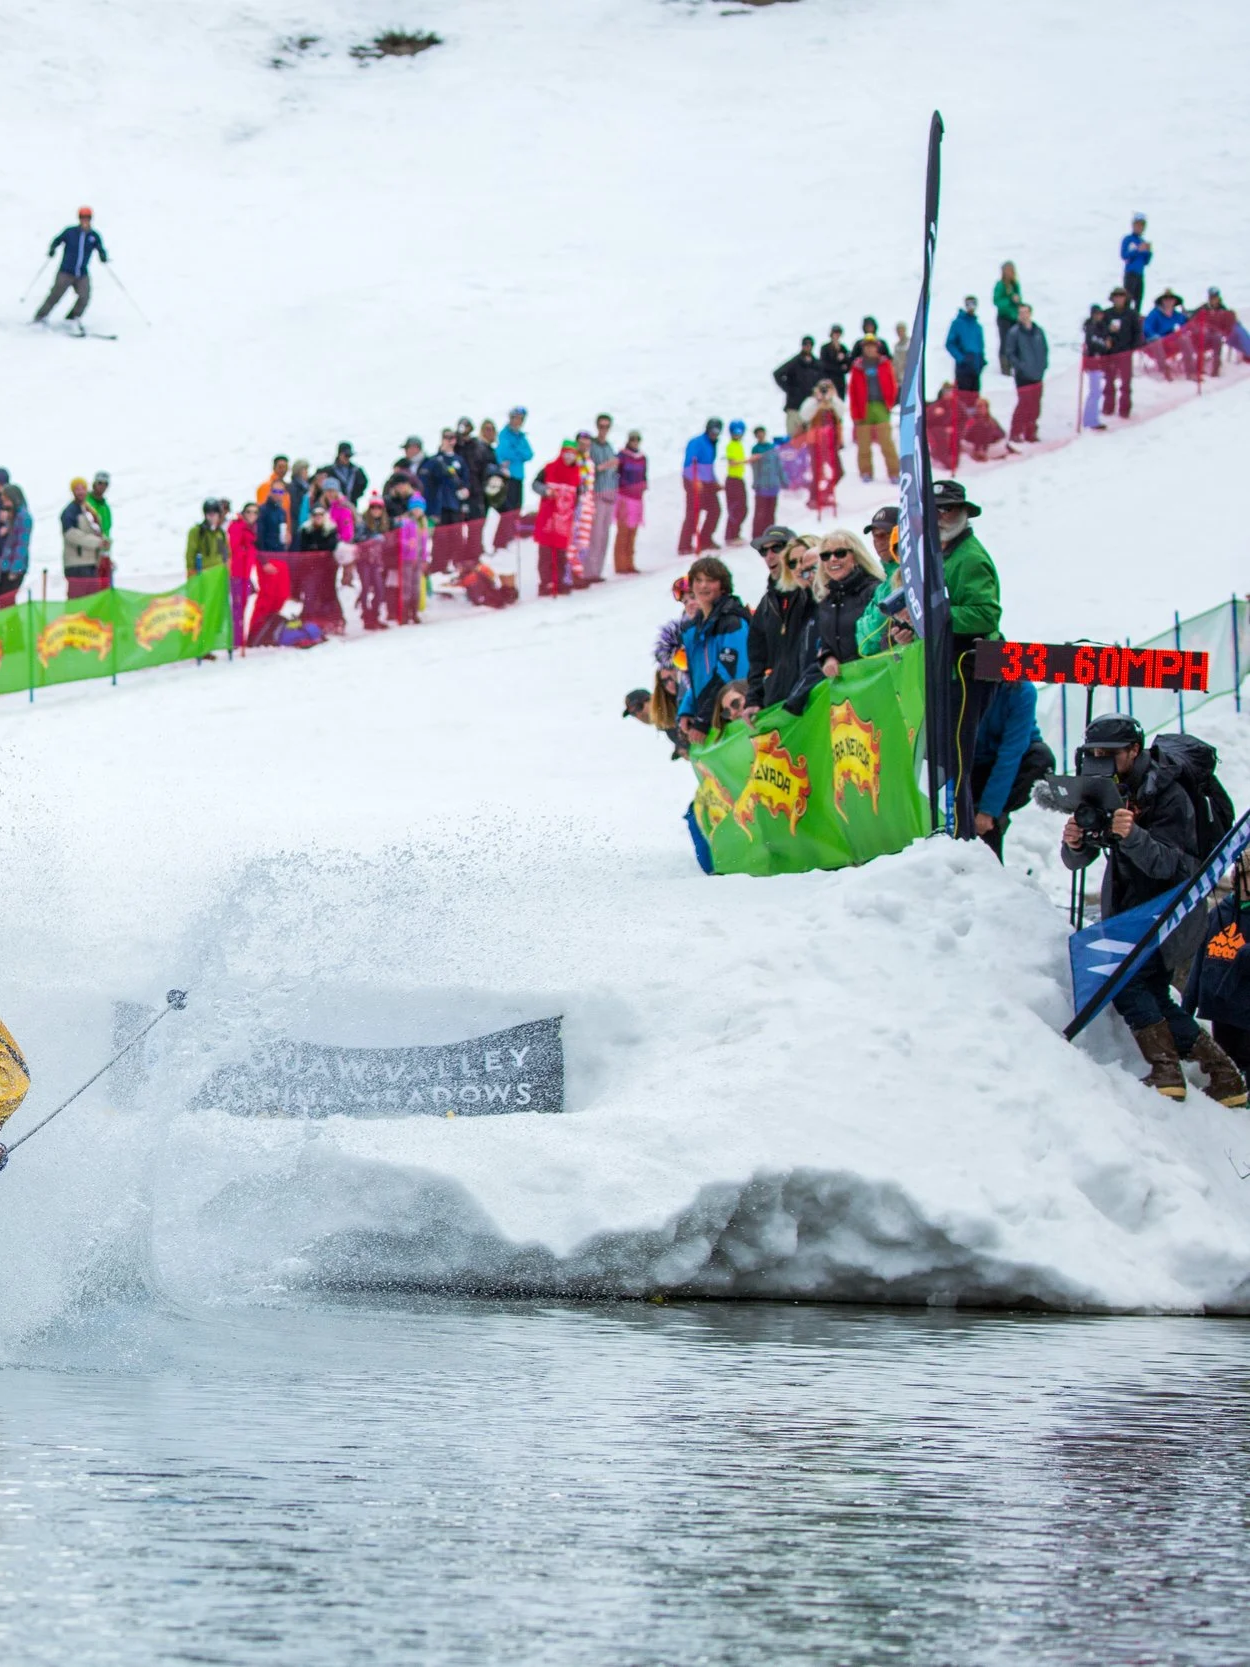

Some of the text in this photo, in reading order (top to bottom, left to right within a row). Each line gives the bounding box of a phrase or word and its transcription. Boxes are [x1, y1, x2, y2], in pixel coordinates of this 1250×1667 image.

[1001, 641, 1209, 690] 33.60MPH
[753, 764, 791, 796] EVADA
[383, 1046, 531, 1083] VALLEY
